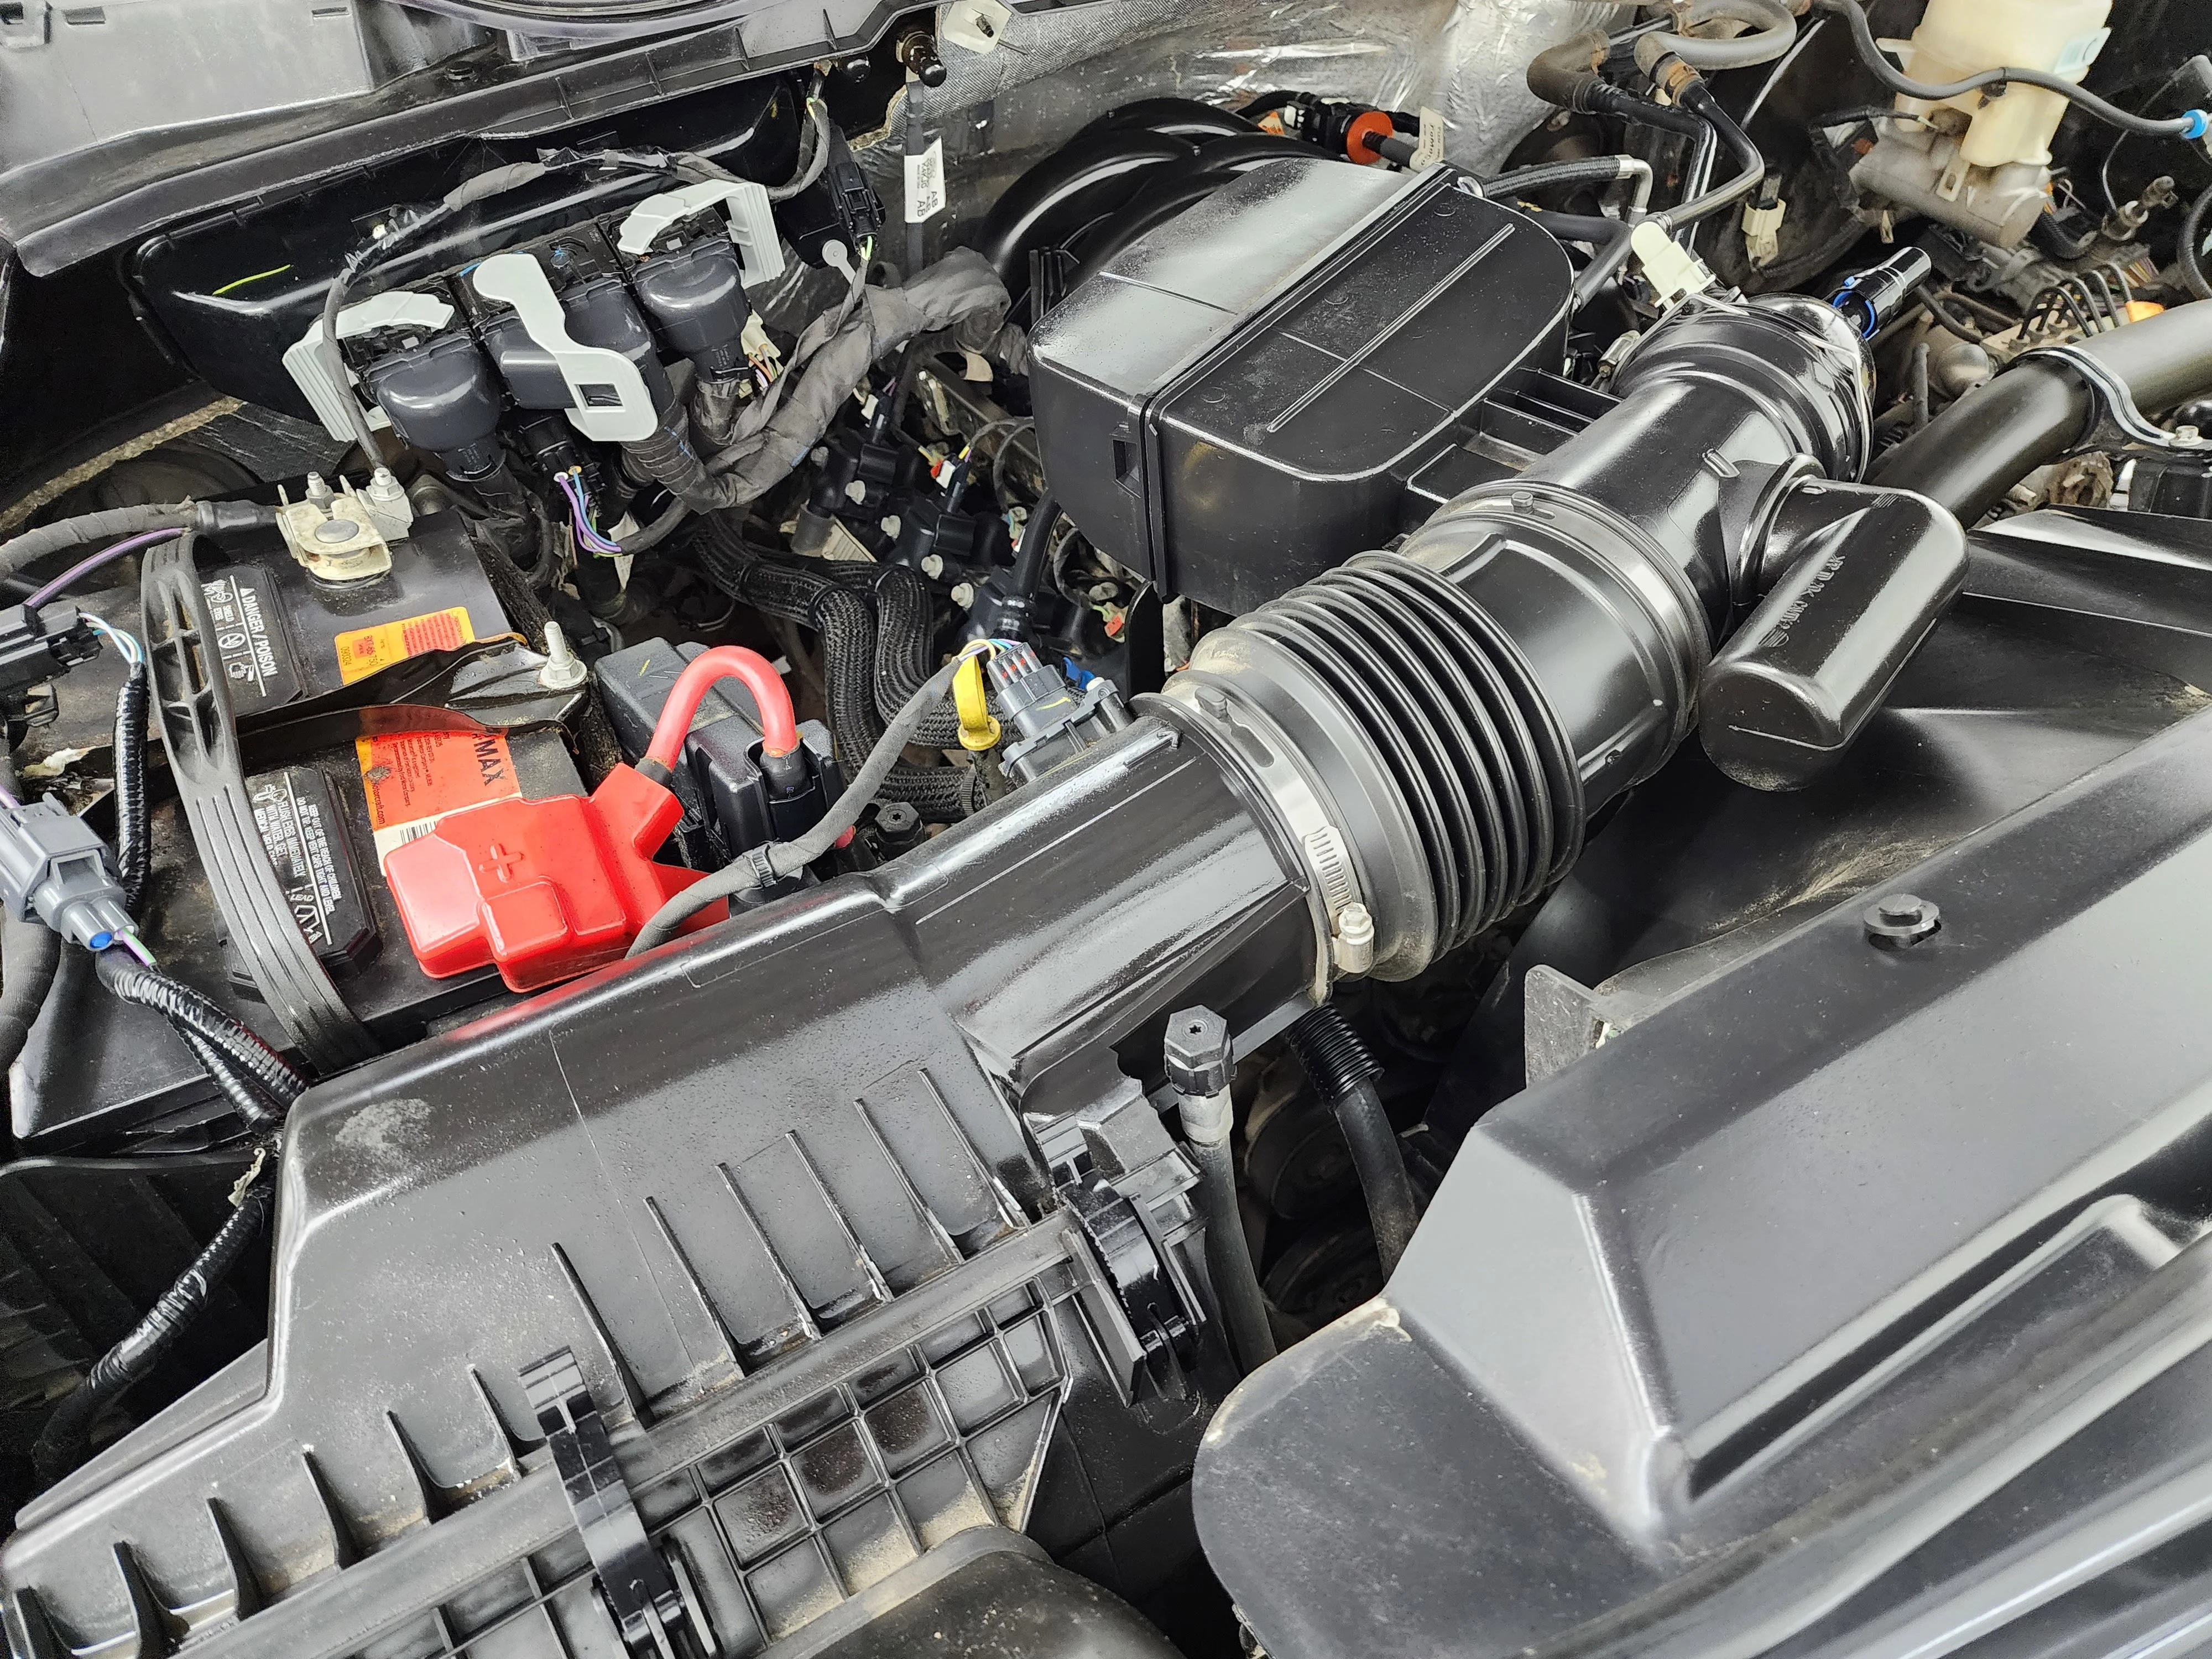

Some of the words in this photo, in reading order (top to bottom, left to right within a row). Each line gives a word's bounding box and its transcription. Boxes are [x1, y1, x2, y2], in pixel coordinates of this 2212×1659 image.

[474, 738, 505, 786] MAX
[297, 797, 306, 806] DO
[277, 801, 292, 821] FLUSH
[299, 805, 310, 817] NOT
[309, 804, 319, 817] KEEP
[283, 821, 296, 837] EYES
[312, 817, 322, 828] OUT
[266, 804, 279, 821] WITH
[275, 843, 288, 857] GET
[305, 826, 316, 840] KEEP
[315, 828, 324, 837] OF
[317, 837, 327, 848] THE
[285, 836, 307, 878] IMMEDIATELY
[311, 853, 323, 868] CAPS
[325, 864, 334, 874] OF
[315, 868, 327, 884] TIGHT
[320, 884, 331, 897] AND
